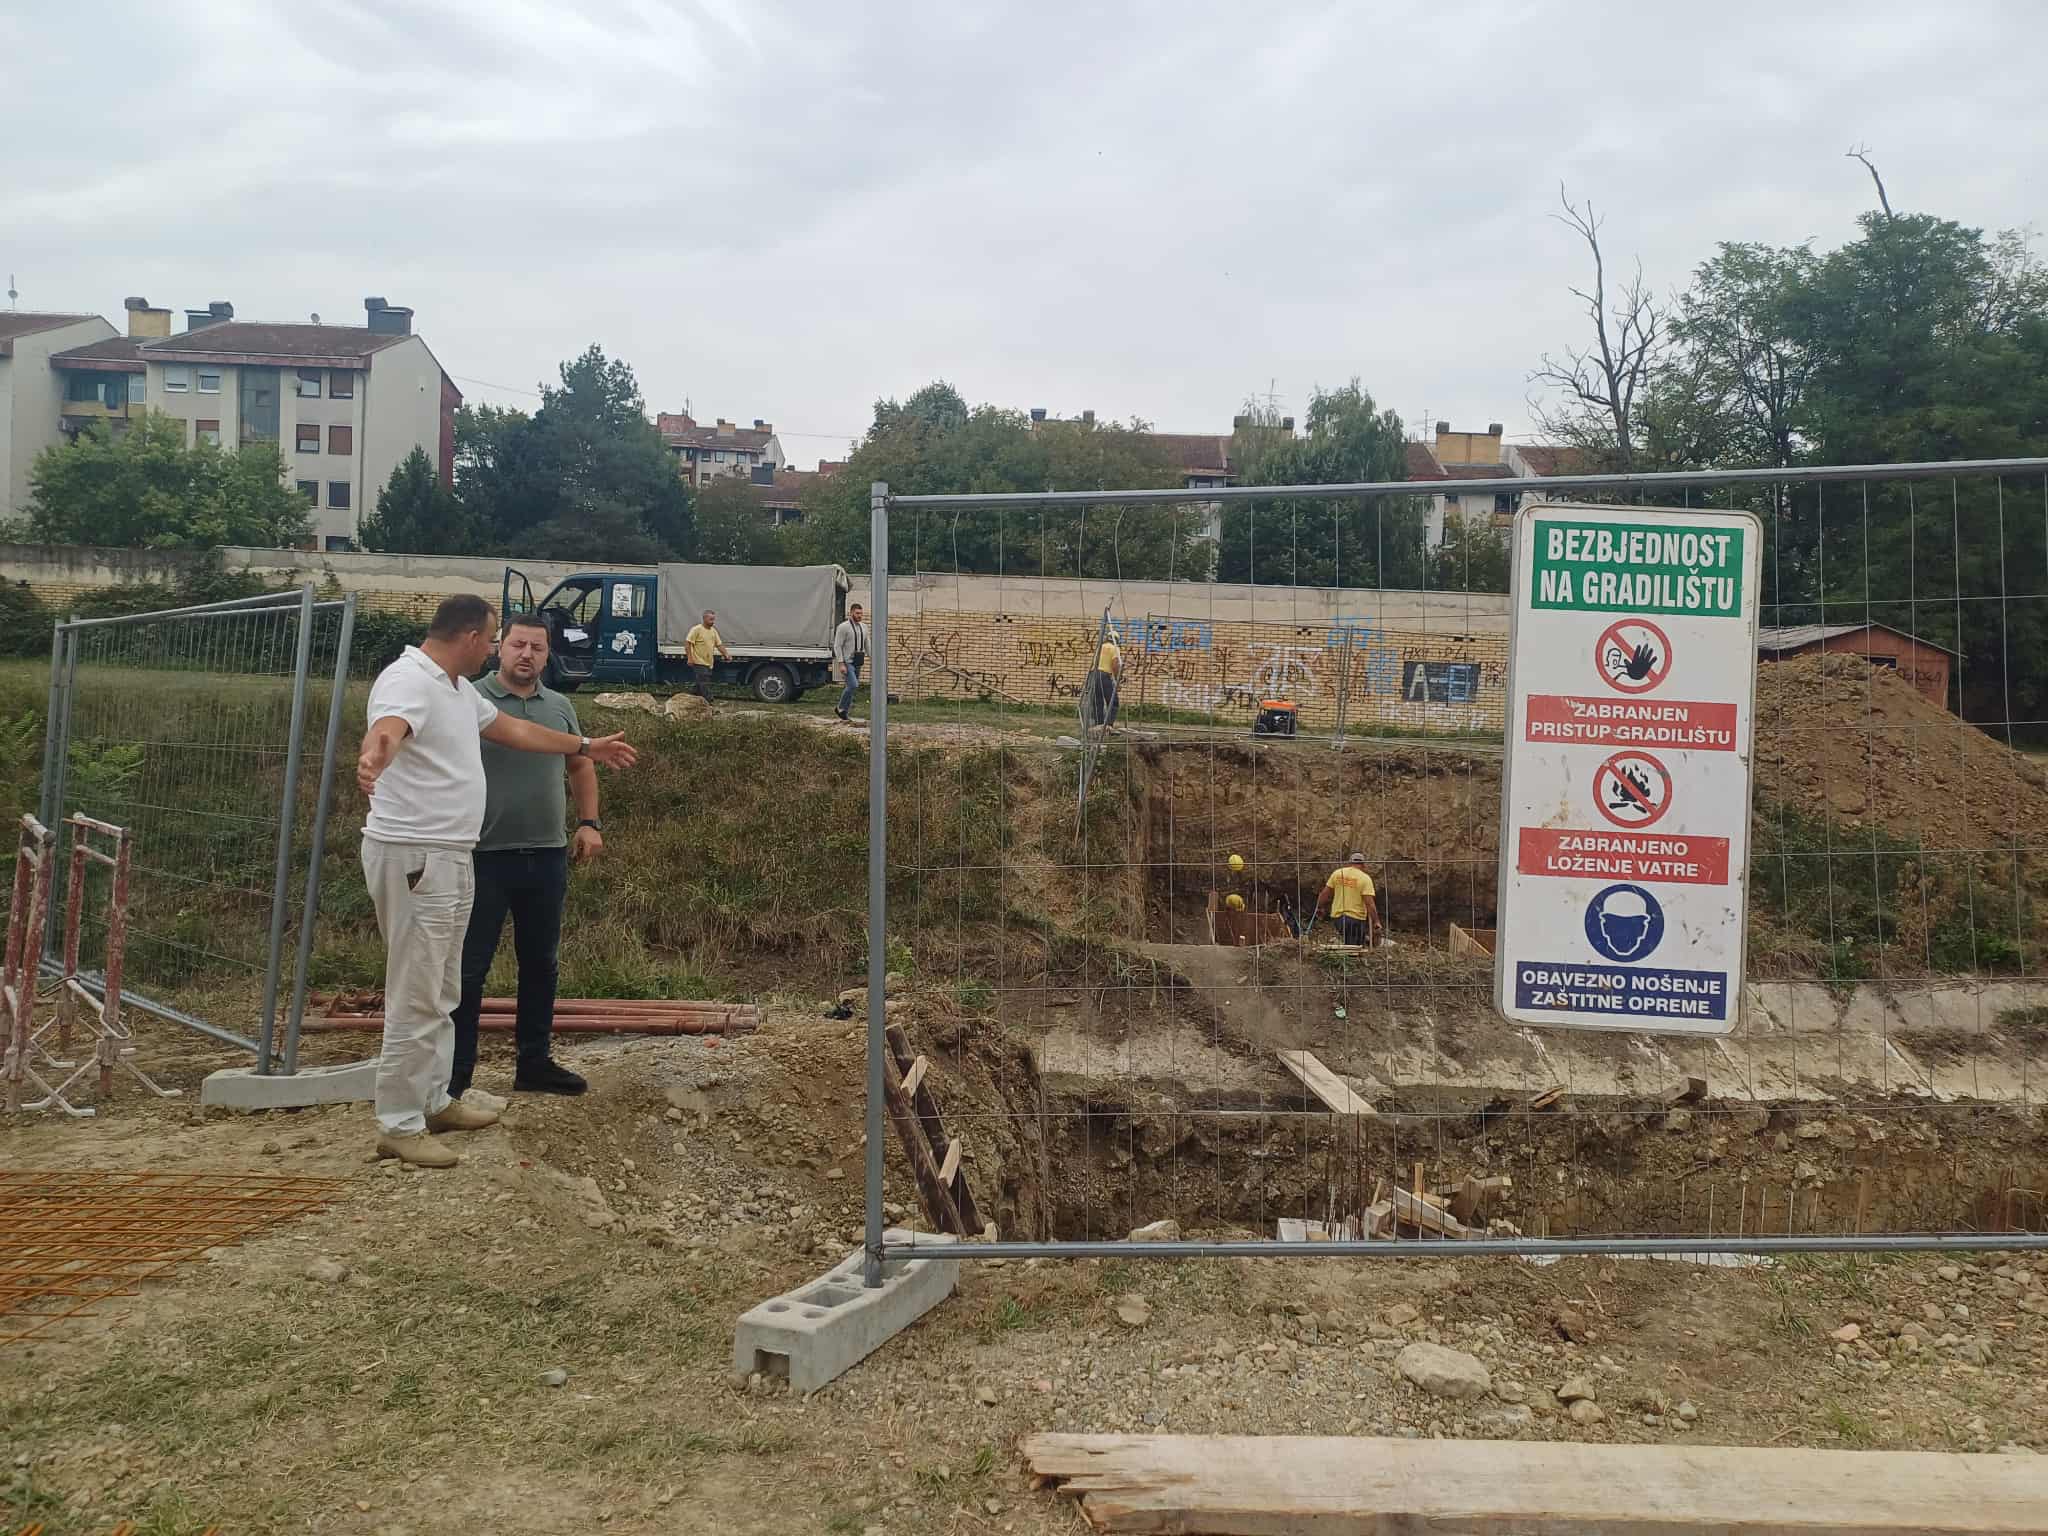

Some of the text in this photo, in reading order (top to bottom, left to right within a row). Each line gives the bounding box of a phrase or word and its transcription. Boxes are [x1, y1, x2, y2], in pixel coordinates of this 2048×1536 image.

[1547, 528, 1731, 568] BEZBJEDNOST
[1539, 568, 1735, 610] NA GRADILIŠTU
[1573, 703, 1689, 722] ZABRANJEN
[1530, 722, 1731, 744] PRISTUP GRADILIŠTU
[1558, 836, 1689, 856] ZABRANJENO
[1547, 854, 1699, 877] LOŽENJE VATRE
[1522, 970, 1721, 994] OBAVEZNO NOŠENJE
[1531, 991, 1710, 1015] ZAŠTITNE OPREME
